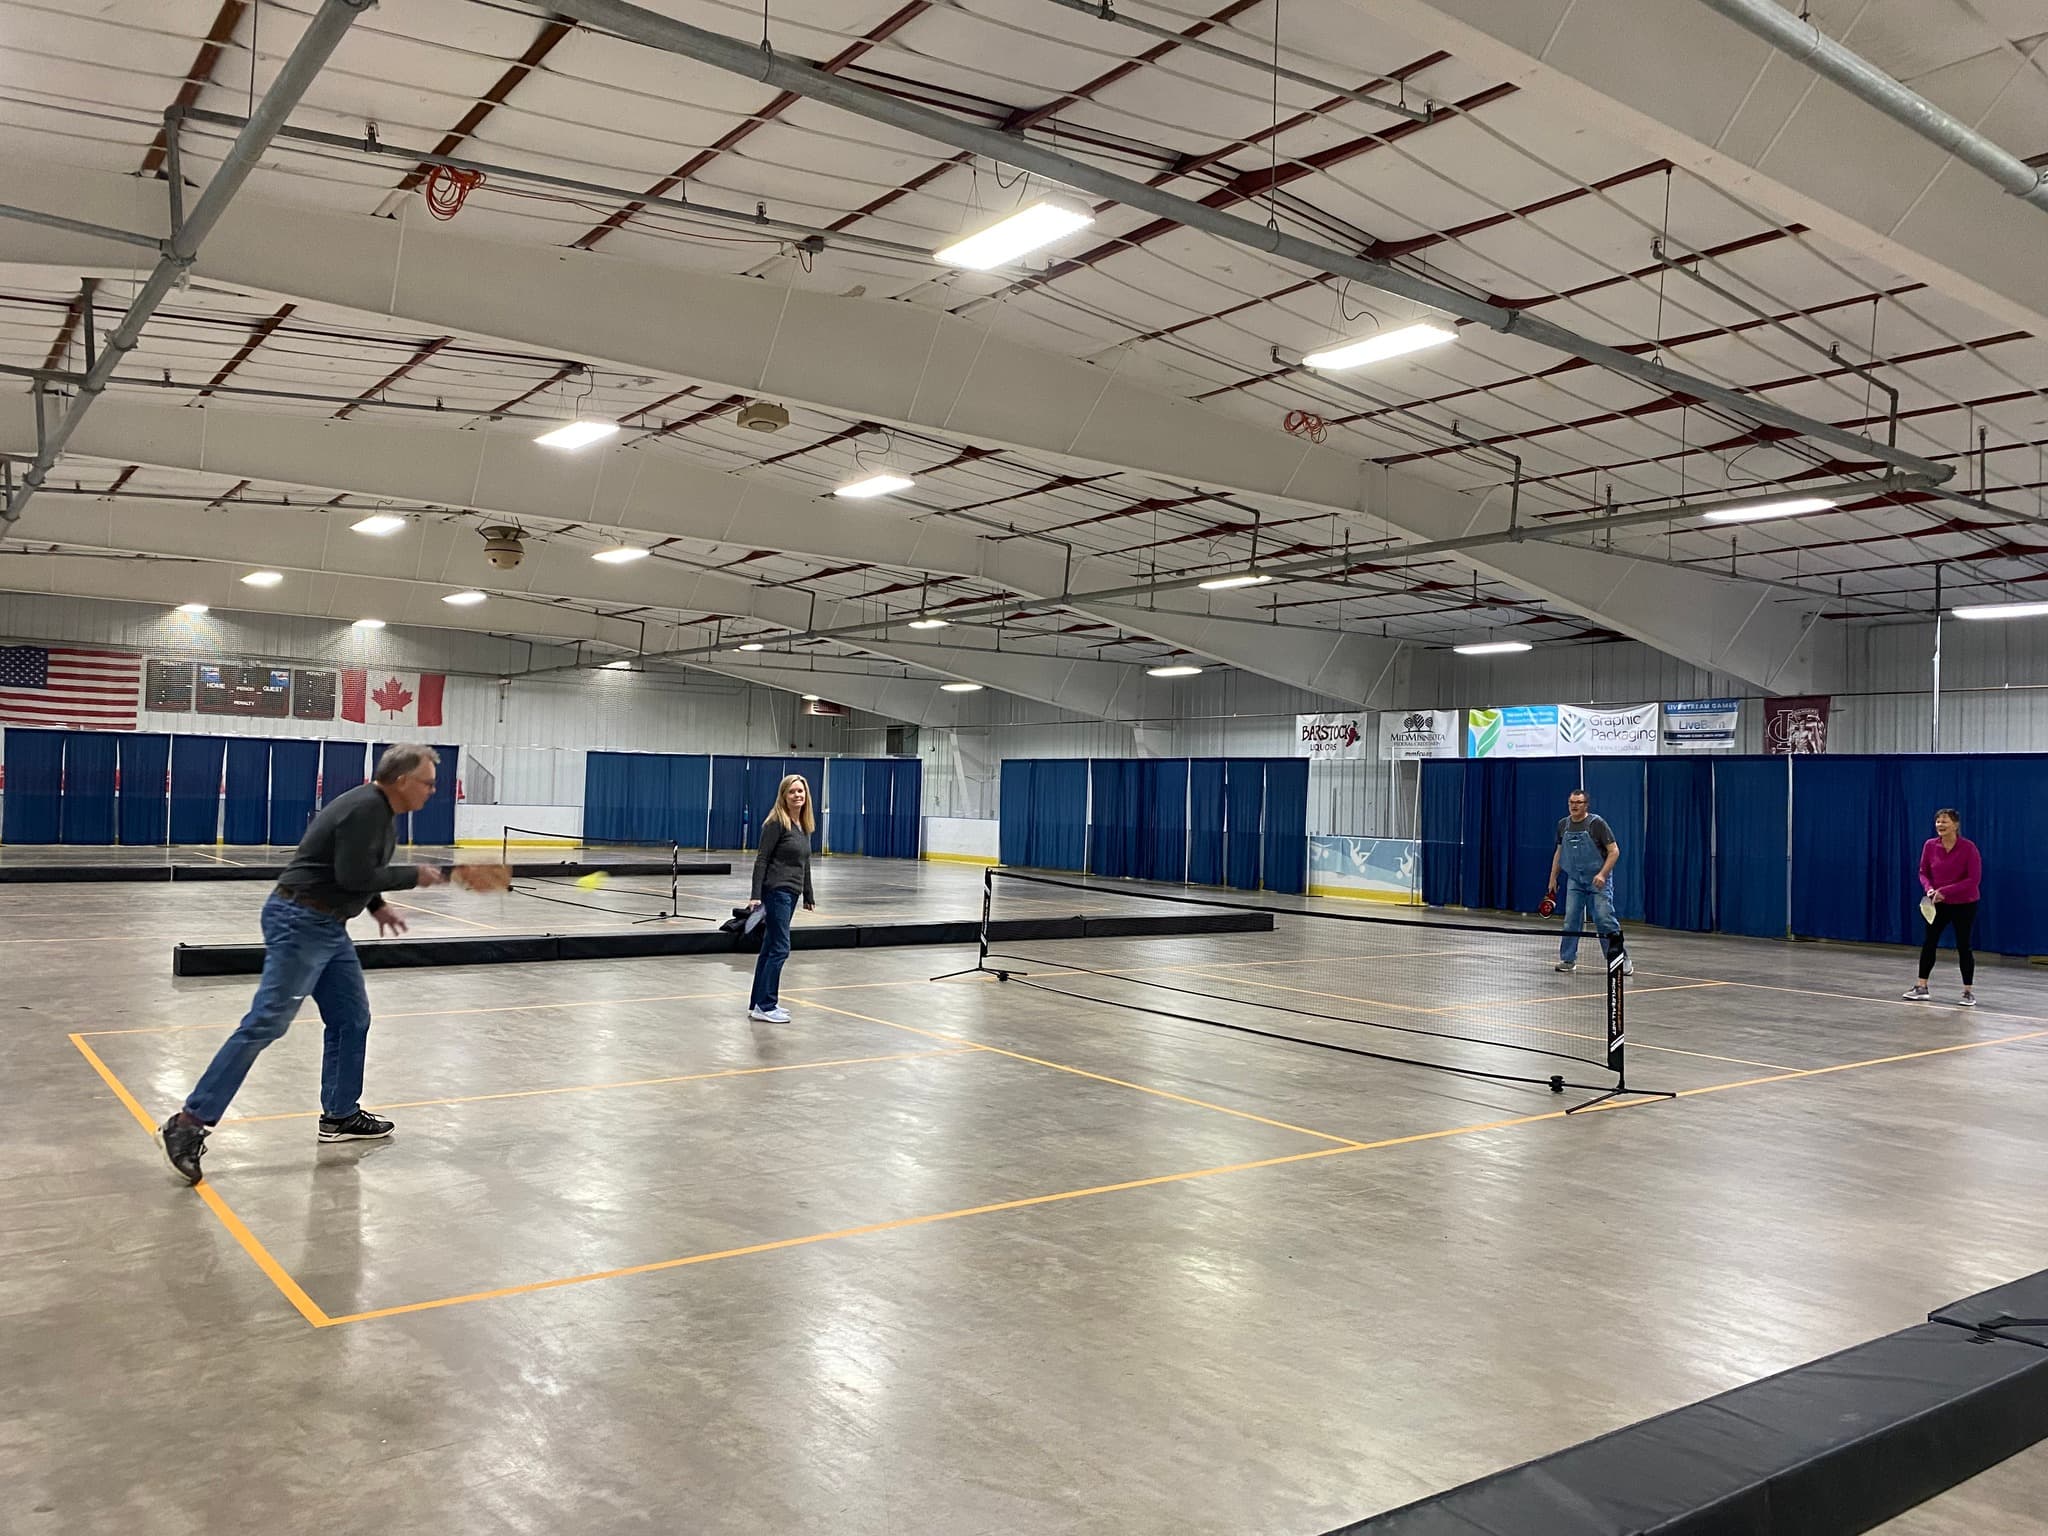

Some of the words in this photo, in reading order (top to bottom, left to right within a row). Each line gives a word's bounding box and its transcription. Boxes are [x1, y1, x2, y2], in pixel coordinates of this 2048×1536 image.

[262, 685, 283, 693] GUEST
[1589, 714, 1641, 729] Graphic
[1302, 724, 1350, 742] BARSTOCK
[1591, 727, 1657, 743] Packaging
[1309, 743, 1337, 751] LIQUORS
